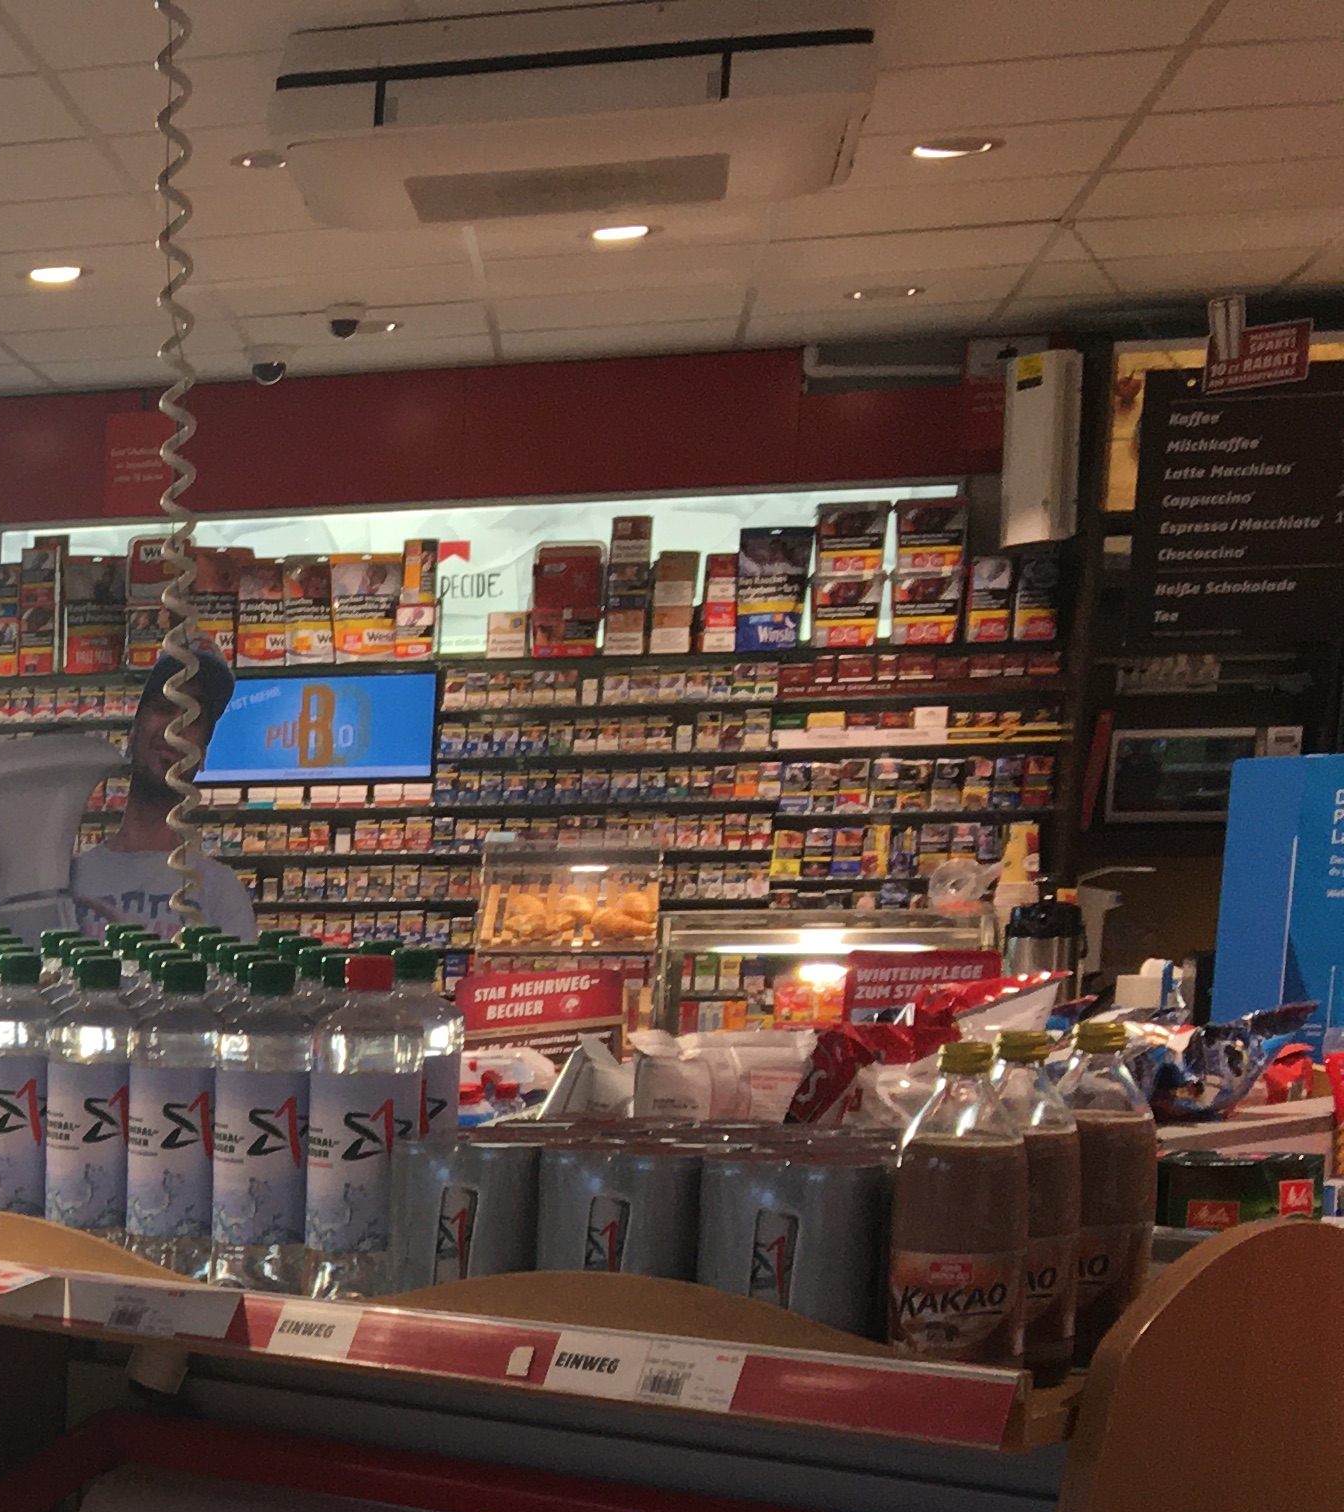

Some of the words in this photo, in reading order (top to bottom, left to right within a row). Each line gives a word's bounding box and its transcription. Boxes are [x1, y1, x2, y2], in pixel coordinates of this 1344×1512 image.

[1169, 411, 1220, 427] Kaffee
[1167, 437, 1260, 454] Milchkaffee
[1165, 467, 1206, 481] Latte
[1211, 463, 1292, 479] Macchiato
[1162, 494, 1252, 508] Cappuccino
[1160, 521, 1228, 536] Espresso
[1240, 517, 1318, 532] Macchiato
[1158, 549, 1245, 562] Chococcino
[1156, 582, 1200, 598] Heiße
[1206, 579, 1297, 595] Schokolade
[1154, 611, 1179, 623] Tee
[856, 964, 984, 982] WINTERPFLEGE
[474, 985, 506, 1003] STAR
[510, 974, 601, 999] MEHRWEG-
[854, 983, 890, 1000] ZUM
[485, 999, 544, 1021] BECHER
[899, 1281, 1008, 1317] KAKAO
[278, 1319, 335, 1339] EINWEG
[554, 1351, 622, 1375] EINWEG
